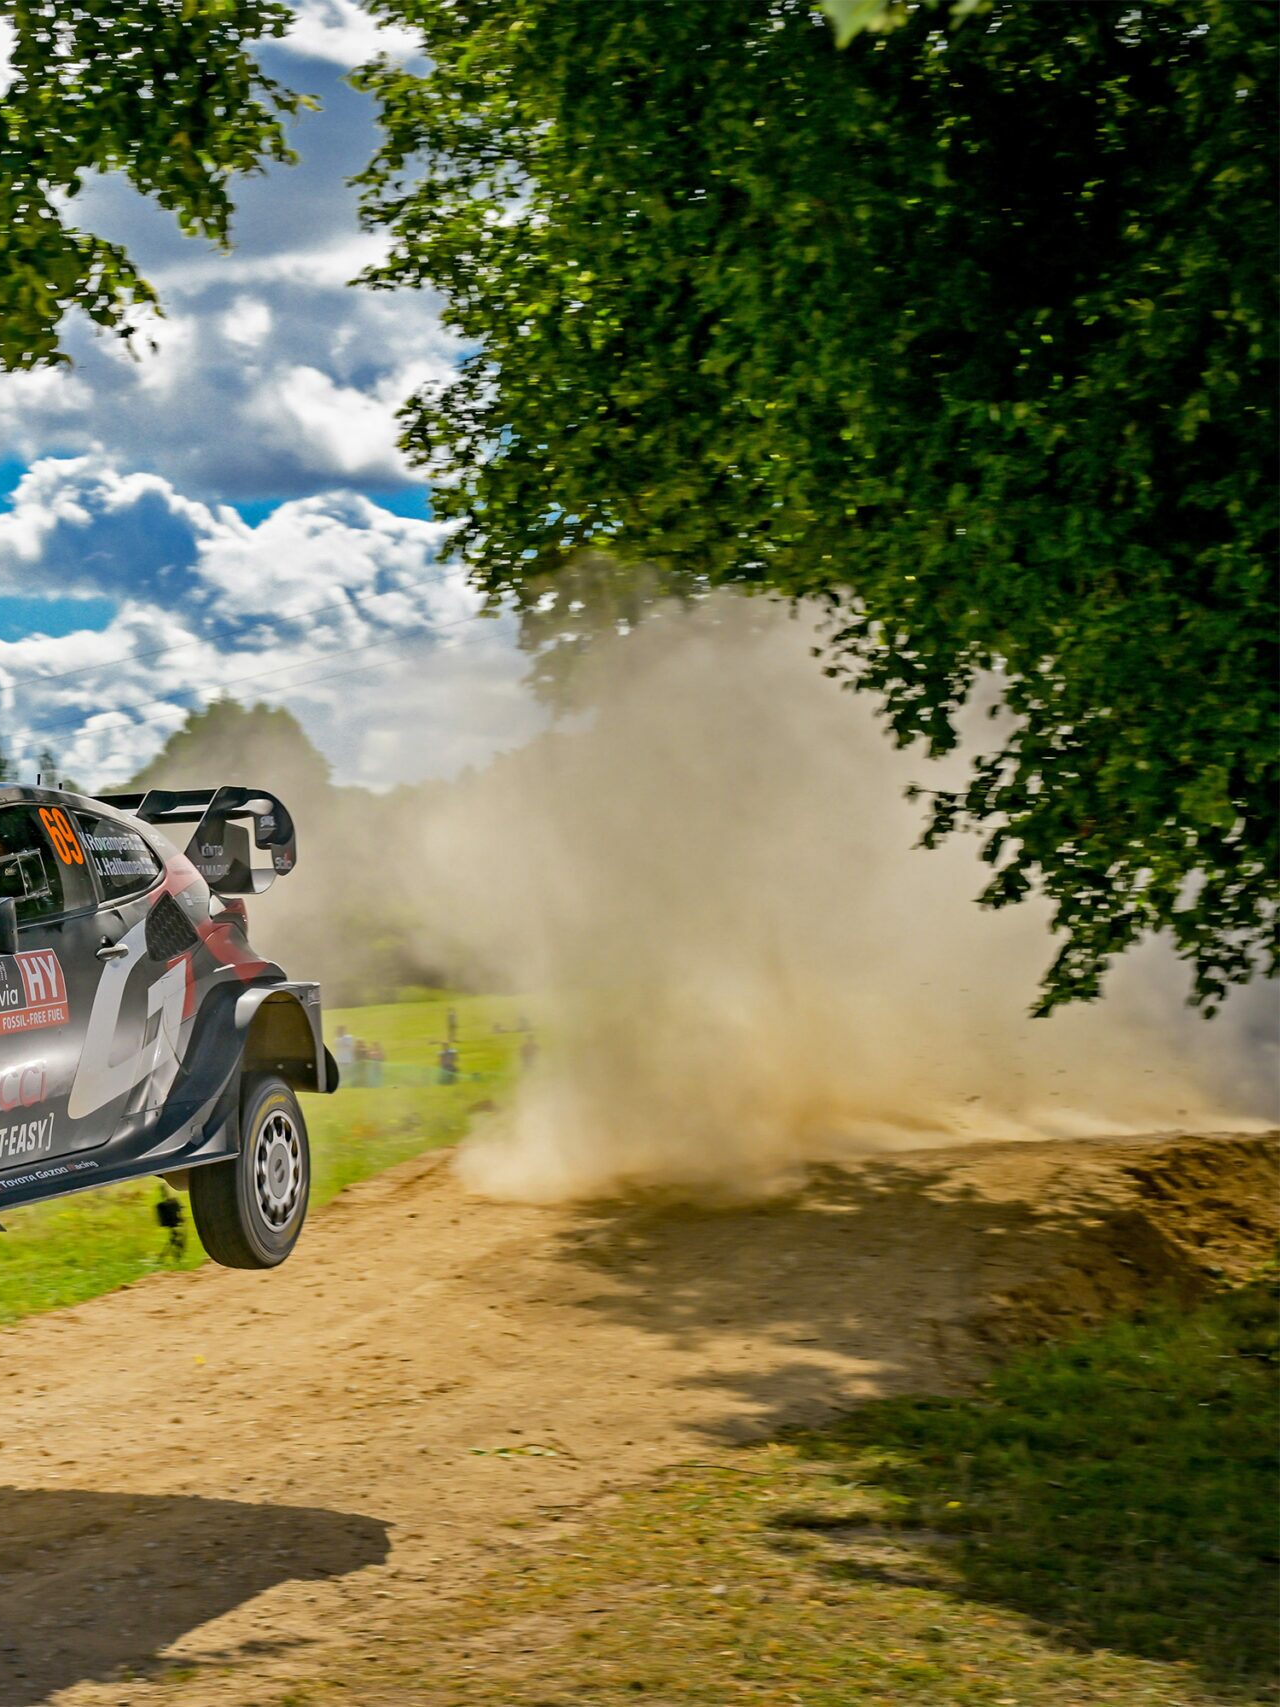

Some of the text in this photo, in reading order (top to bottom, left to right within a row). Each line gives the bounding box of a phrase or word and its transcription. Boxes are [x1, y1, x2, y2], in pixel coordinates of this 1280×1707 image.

[38, 807, 84, 865] 69
[21, 955, 58, 1001] HY
[2, 1011, 46, 1030] FOSSIL-FREE
[47, 1008, 64, 1023] FUEL
[0, 1174, 37, 1188] TOYOTA
[36, 1166, 68, 1179] GAZOO
[66, 1160, 99, 1173] Racing
